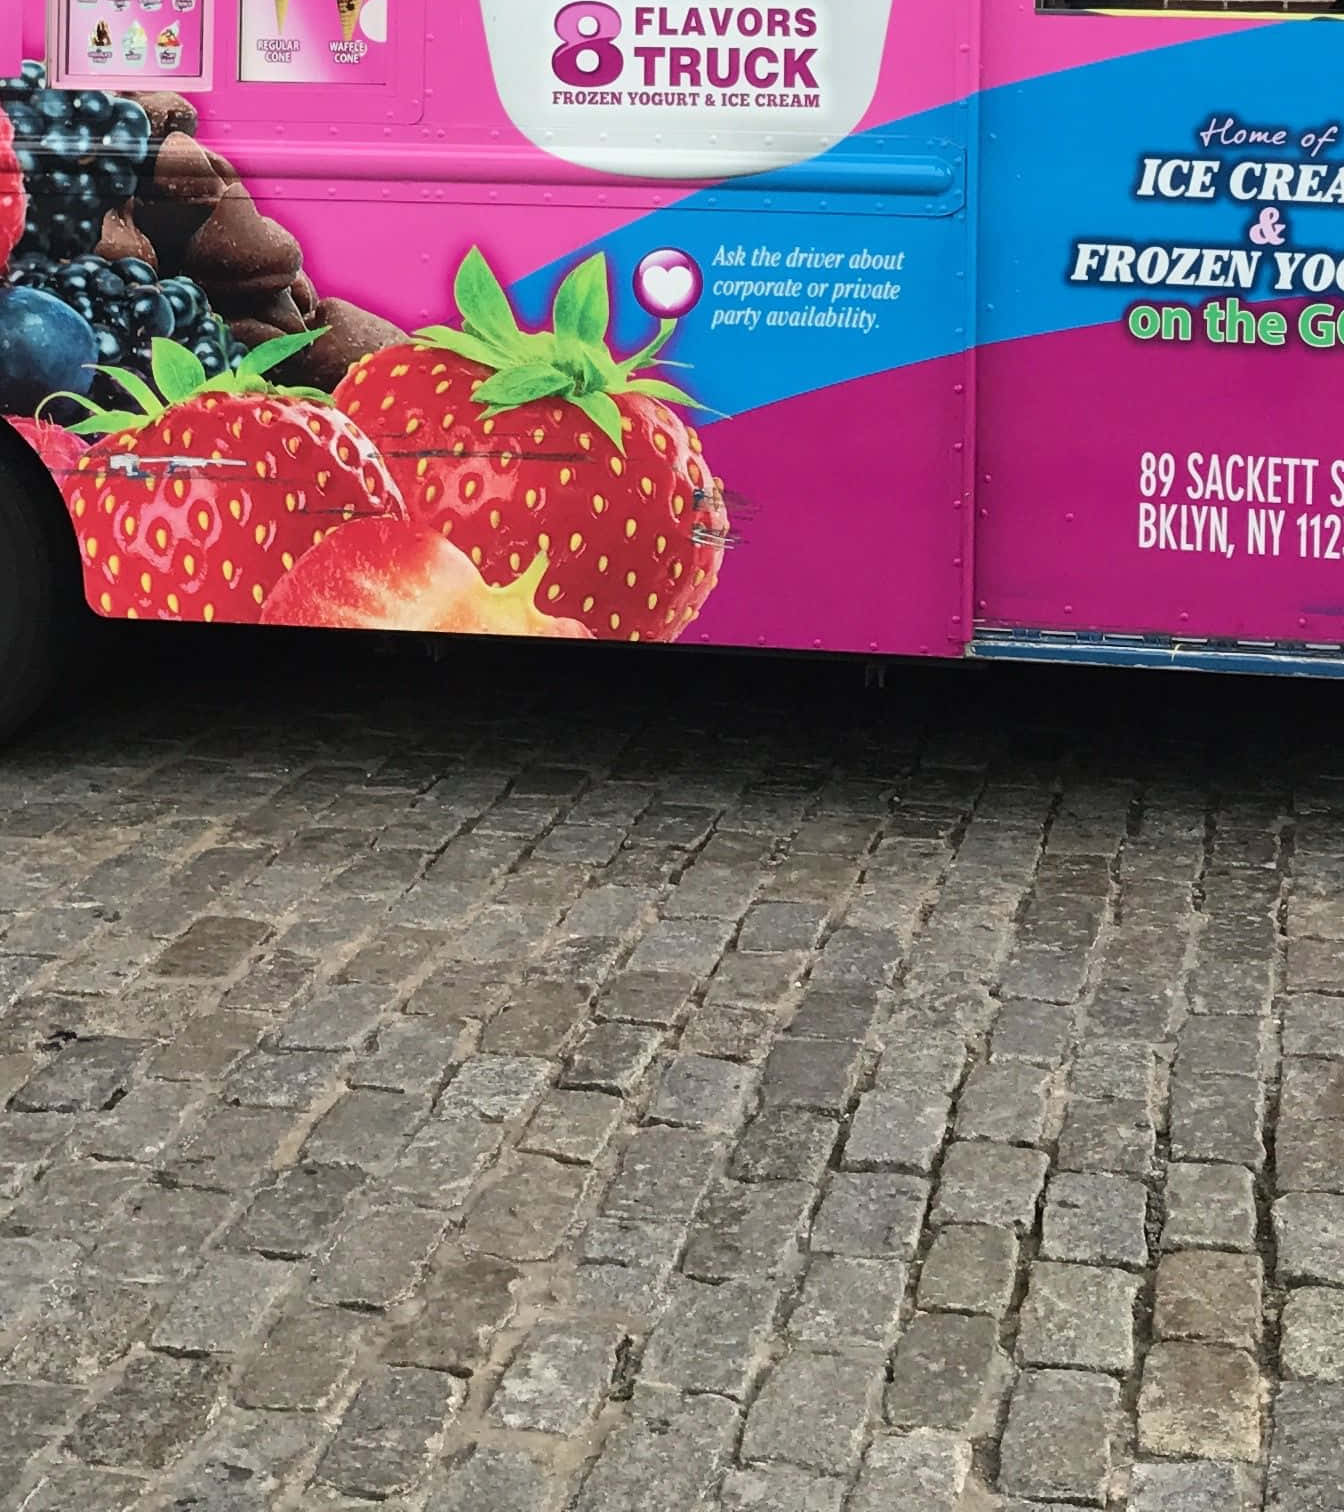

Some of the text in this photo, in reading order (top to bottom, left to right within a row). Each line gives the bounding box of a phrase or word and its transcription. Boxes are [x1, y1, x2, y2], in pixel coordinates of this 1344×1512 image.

[257, 39, 300, 51] REGULAR
[265, 51, 291, 63] CONE
[330, 41, 365, 52] WAFFLE
[334, 53, 360, 64] CONE
[551, 0, 818, 88] 8 FLAVORS
[633, 46, 820, 89] TRUCK
[552, 90, 821, 109] FROZEN YOGURT & ICE CREAM
[1200, 117, 1339, 157] Home of
[1137, 157, 1220, 199] ICE
[1249, 207, 1286, 246] &
[711, 244, 905, 272] Ask the driver about
[1070, 243, 1263, 289] FROZEN
[713, 277, 901, 303] corporate or private
[710, 306, 881, 332] party availability.
[1129, 303, 1193, 341] on
[1204, 298, 1288, 345] the
[1139, 451, 1175, 497] 89
[1185, 452, 1320, 507] SACKETT
[1138, 502, 1236, 559] BKLYN,
[1246, 508, 1286, 556] NY
